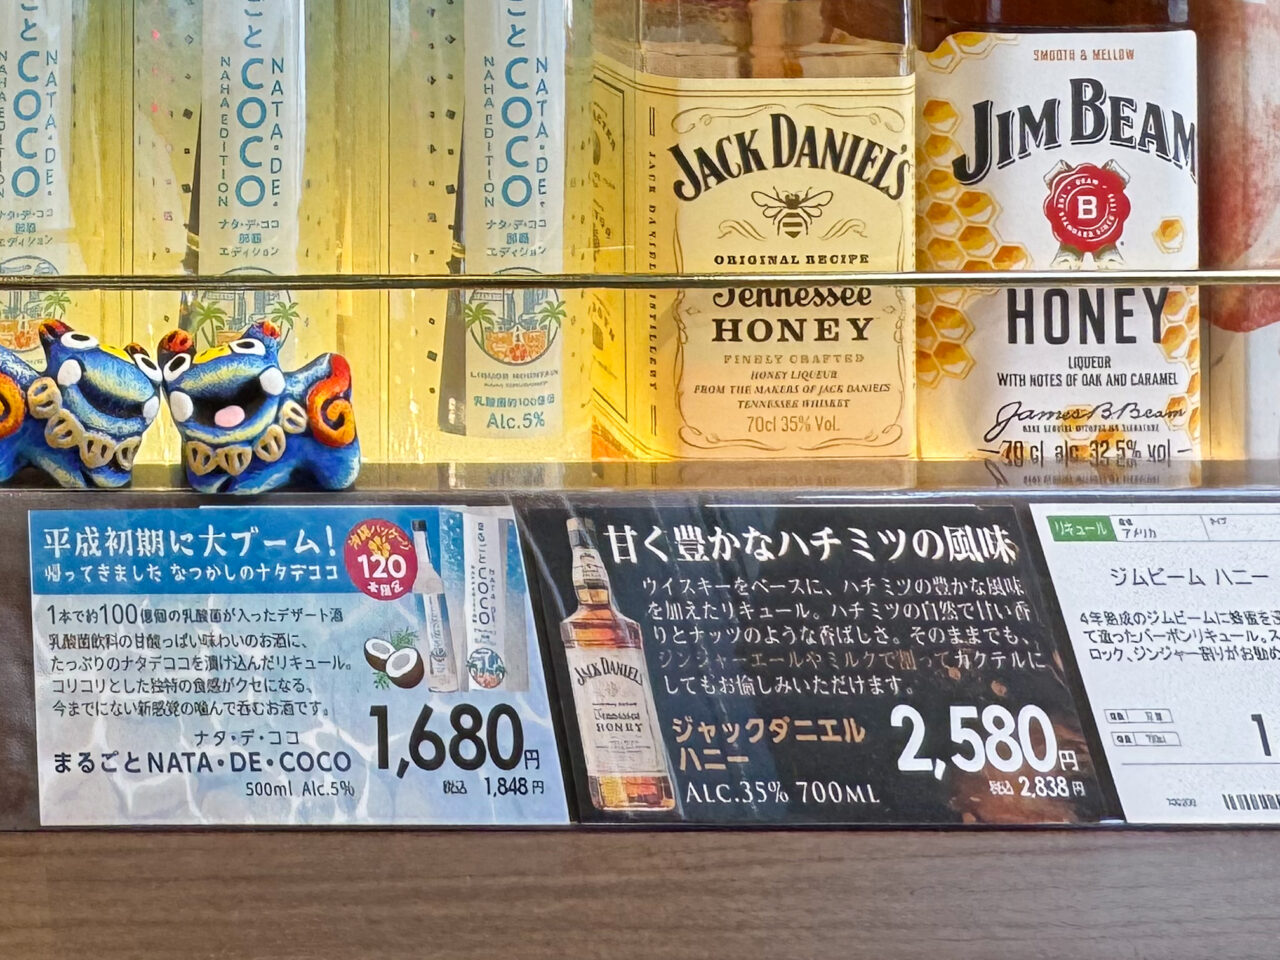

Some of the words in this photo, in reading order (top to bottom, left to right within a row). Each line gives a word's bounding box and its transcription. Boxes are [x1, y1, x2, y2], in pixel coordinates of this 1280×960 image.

[1033, 49, 1075, 61] SMOOTH
[1092, 49, 1135, 61] MELLOW
[11, 50, 42, 198] COCO
[235, 57, 268, 208] COCO
[501, 57, 533, 208] COCO
[952, 99, 1061, 186] JIM
[1069, 78, 1198, 185] BEAM
[666, 128, 769, 202] JACK
[1076, 195, 1098, 219] B
[714, 254, 799, 266] ORIGINAL
[805, 253, 869, 266] RECIPE
[1006, 287, 1170, 345] HONEY
[711, 317, 875, 342] HONEY
[1068, 355, 1112, 369] LIQUEUR
[750, 370, 788, 380] HONEY
[997, 373, 1026, 387] WITH
[1030, 373, 1062, 387] NOTES
[1066, 373, 1078, 386] OF
[1082, 373, 1102, 387] OAK
[1106, 373, 1127, 387] AND
[1131, 372, 1179, 387] CARAMEL
[747, 416, 777, 433] 70cl
[780, 415, 812, 433] 35%
[1054, 520, 1108, 537] リキュール
[603, 523, 1018, 565] 甘く豊かなハチミツの風味
[357, 555, 407, 580] 120
[672, 716, 866, 745] ジャックダニエル
[680, 746, 748, 772] ハニー
[244, 781, 293, 798] 500ml
